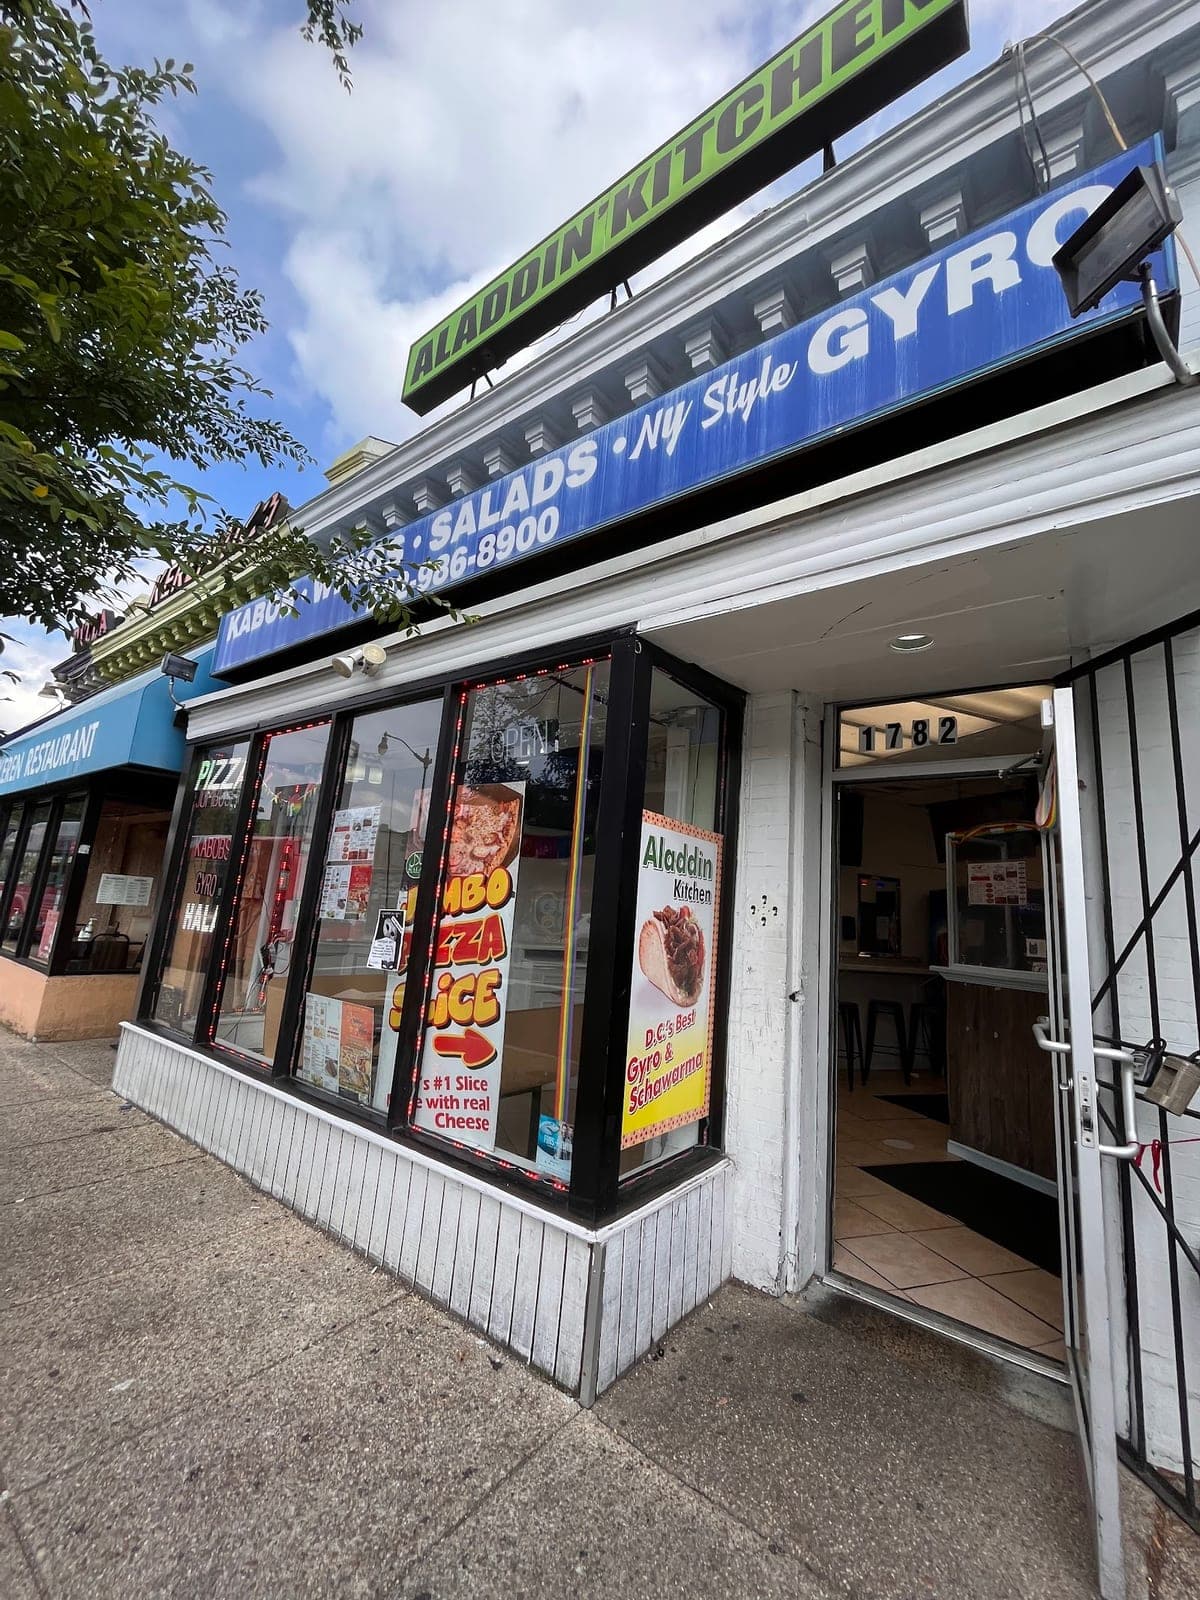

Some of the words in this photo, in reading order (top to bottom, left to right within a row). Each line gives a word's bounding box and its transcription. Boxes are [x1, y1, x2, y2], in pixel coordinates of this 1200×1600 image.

[429, 439, 598, 551] SALADS
[701, 355, 799, 430] Style
[807, 184, 1115, 375] GYRO
[24, 721, 100, 777] RESTAURANT
[490, 717, 549, 763] OPEN
[862, 717, 957, 752] 1782
[642, 835, 713, 882] Aladdin
[194, 871, 217, 897] GYRO
[673, 878, 712, 905] Kitchen
[675, 1009, 697, 1033] Best
[627, 1050, 662, 1083] Gyro
[664, 1042, 674, 1063] &
[456, 1075, 488, 1091] Slice
[628, 1051, 704, 1115] Schawarma
[426, 1095, 460, 1110] with
[463, 1096, 490, 1112] real
[434, 1112, 490, 1131] Cheese
